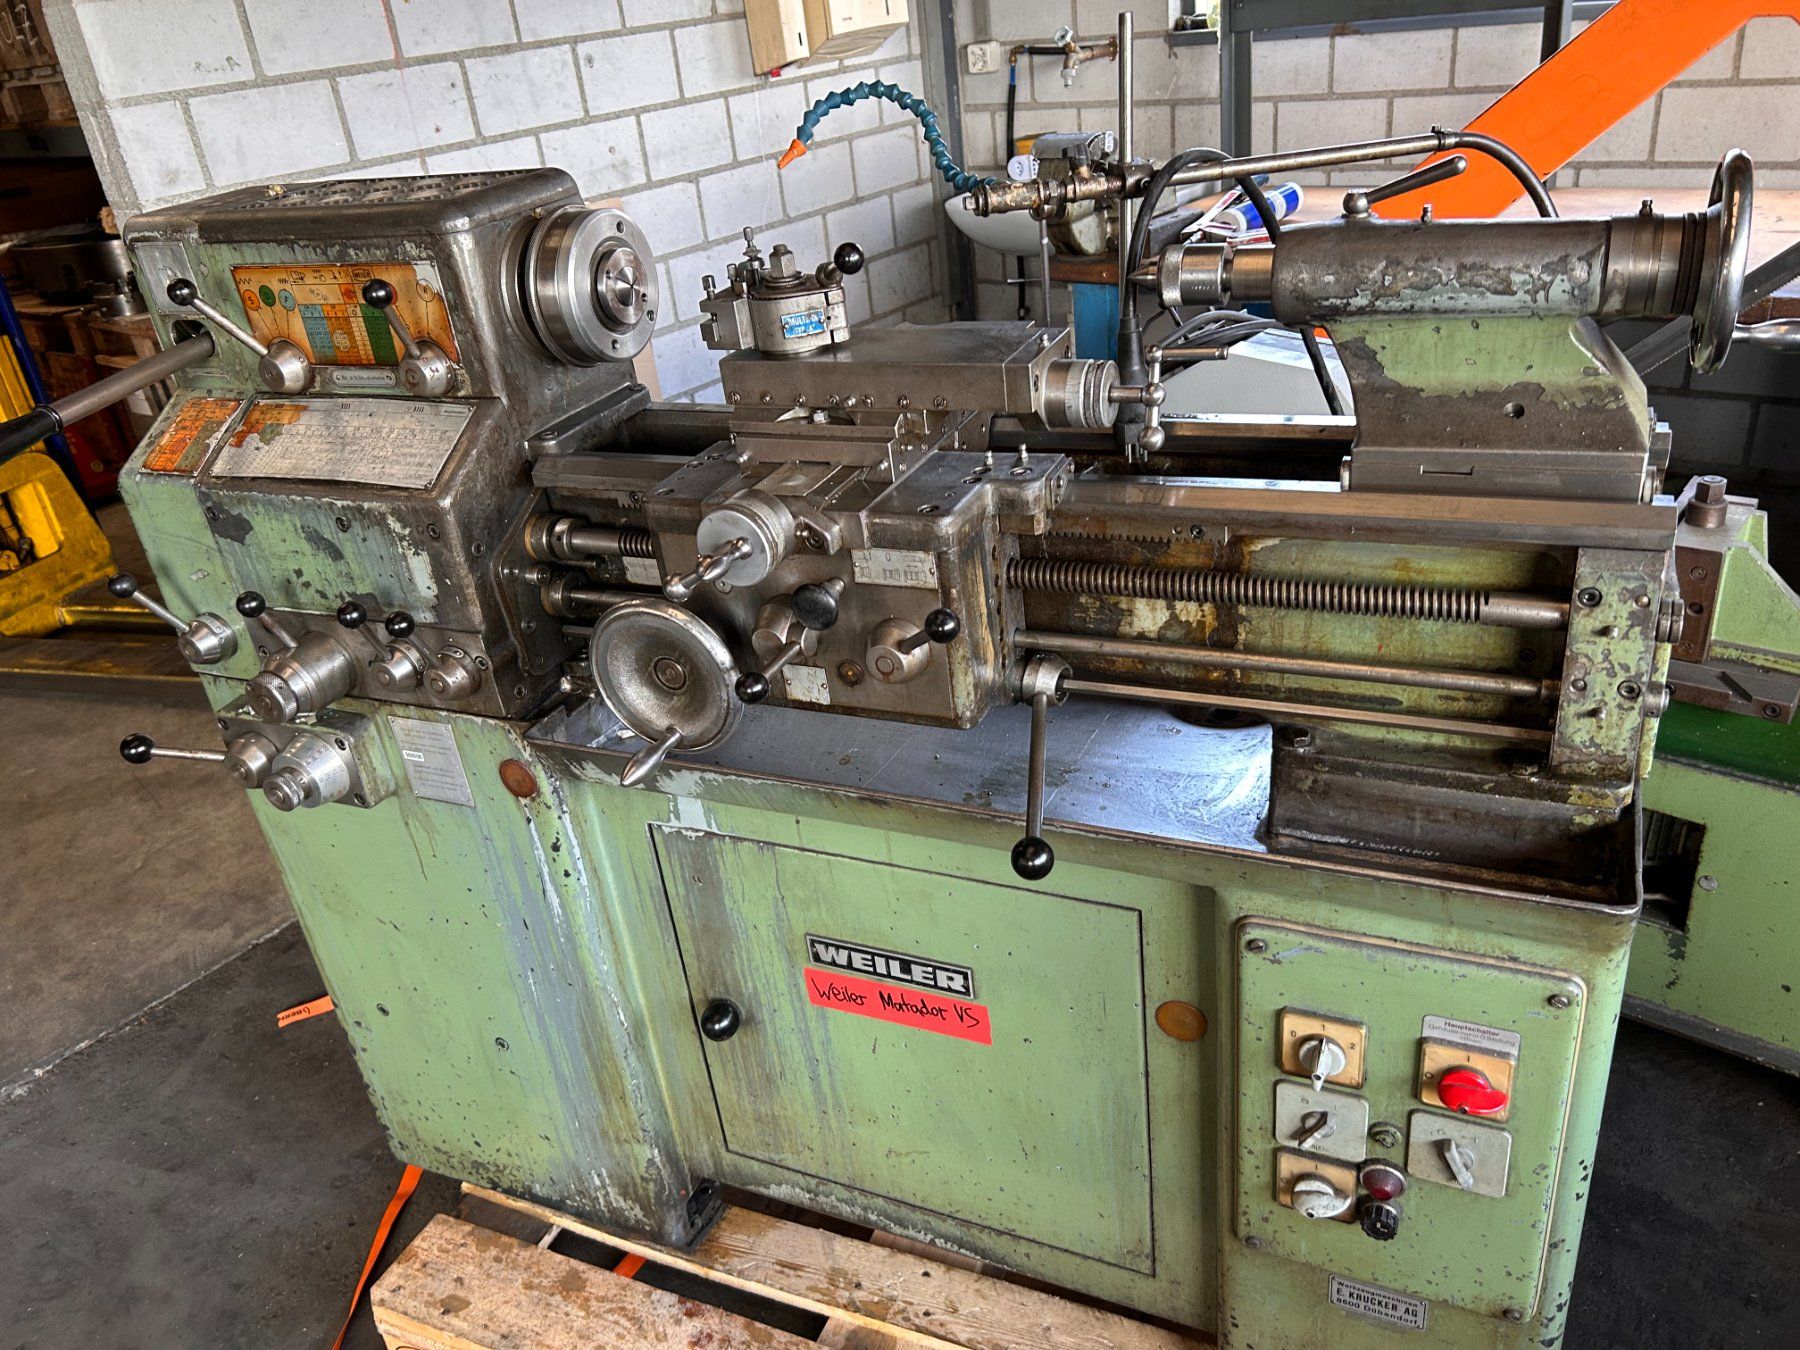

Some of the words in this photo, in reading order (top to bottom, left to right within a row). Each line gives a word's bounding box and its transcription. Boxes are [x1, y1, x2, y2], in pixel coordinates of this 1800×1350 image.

[813, 942, 967, 993] WEILER
[811, 977, 867, 1006] Weiler
[878, 990, 948, 1021] Matador
[953, 1003, 980, 1029] VS
[1321, 1024, 1326, 1032] 1
[1350, 1042, 1356, 1050] 2
[1444, 1020, 1500, 1037] Hauptschalter
[1336, 1297, 1361, 1309] 8600
[1337, 1281, 1418, 1308] Werkzeugmaschinen
[1348, 1290, 1399, 1313] KRUCKER
[1403, 1307, 1418, 1318] AG
